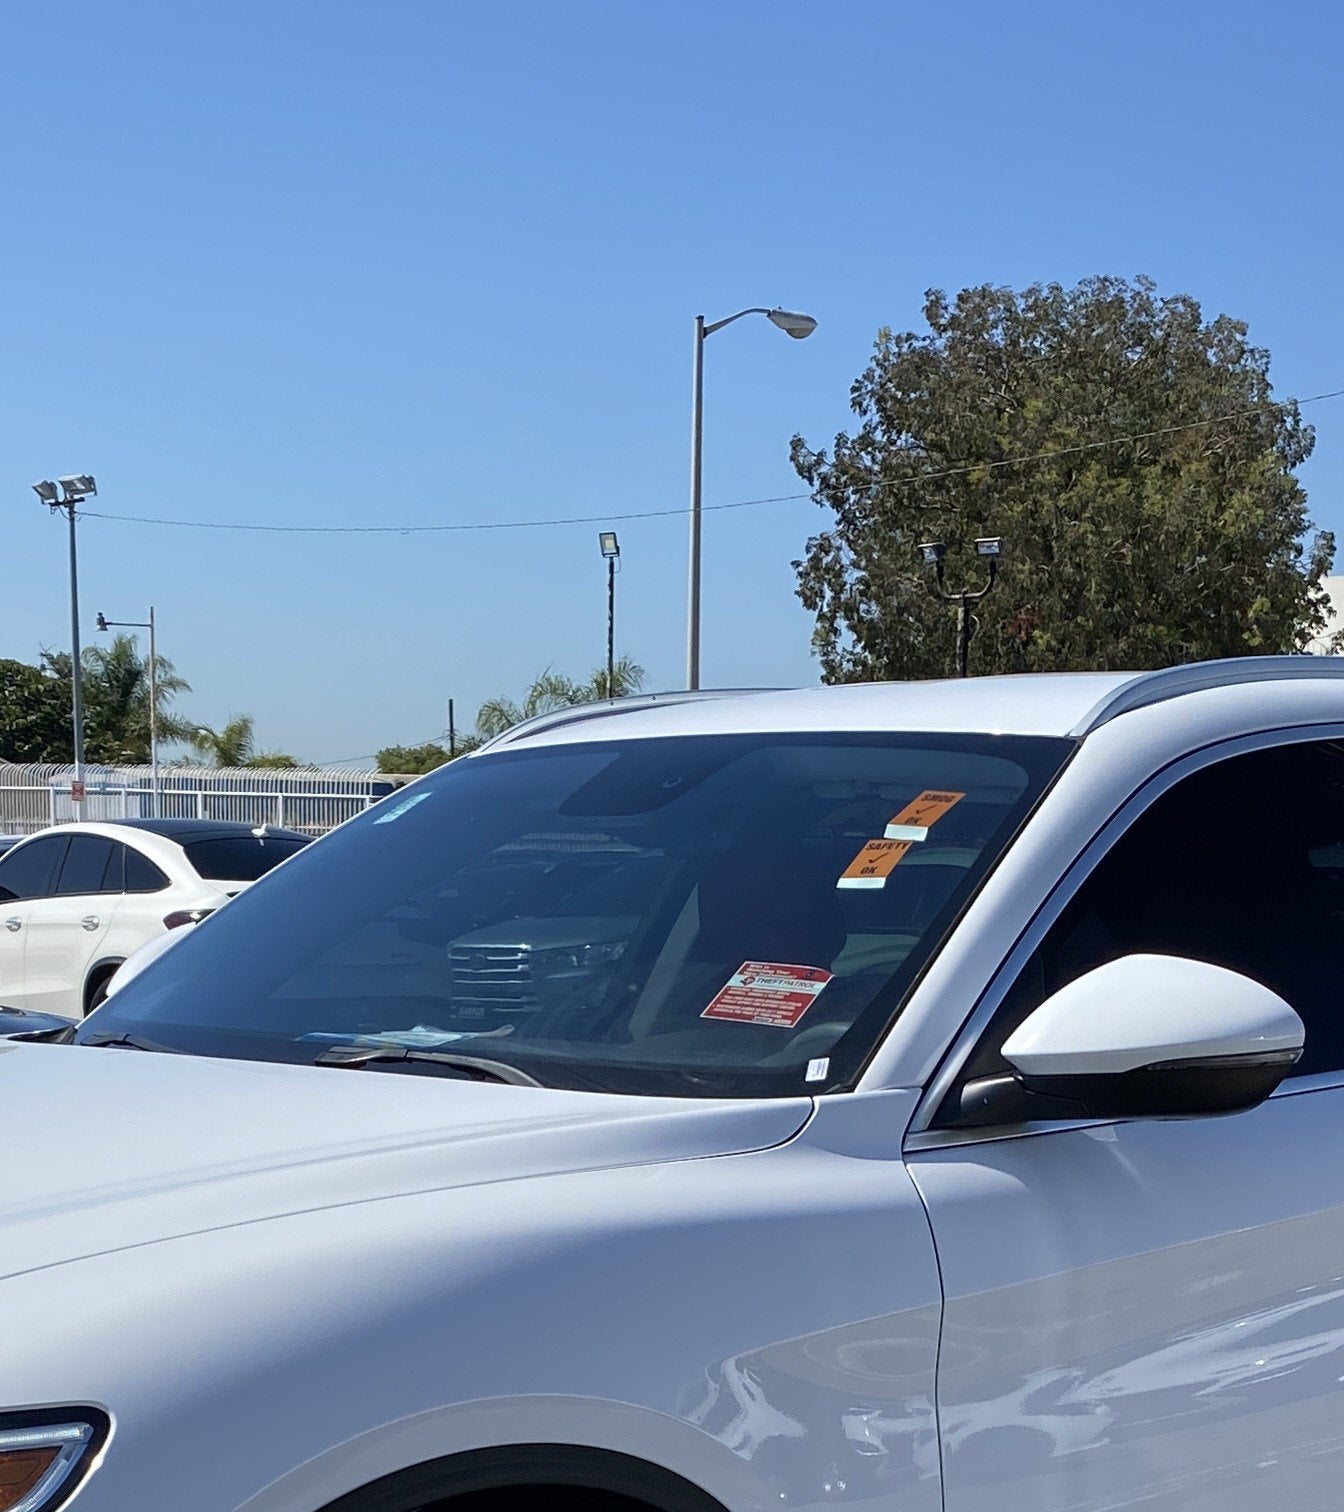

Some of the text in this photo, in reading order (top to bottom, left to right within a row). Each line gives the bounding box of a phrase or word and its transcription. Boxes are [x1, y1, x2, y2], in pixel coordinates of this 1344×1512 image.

[921, 793, 955, 803] SMOG
[904, 817, 923, 825] OK
[865, 842, 910, 851] SAFETY
[860, 866, 878, 875] OK
